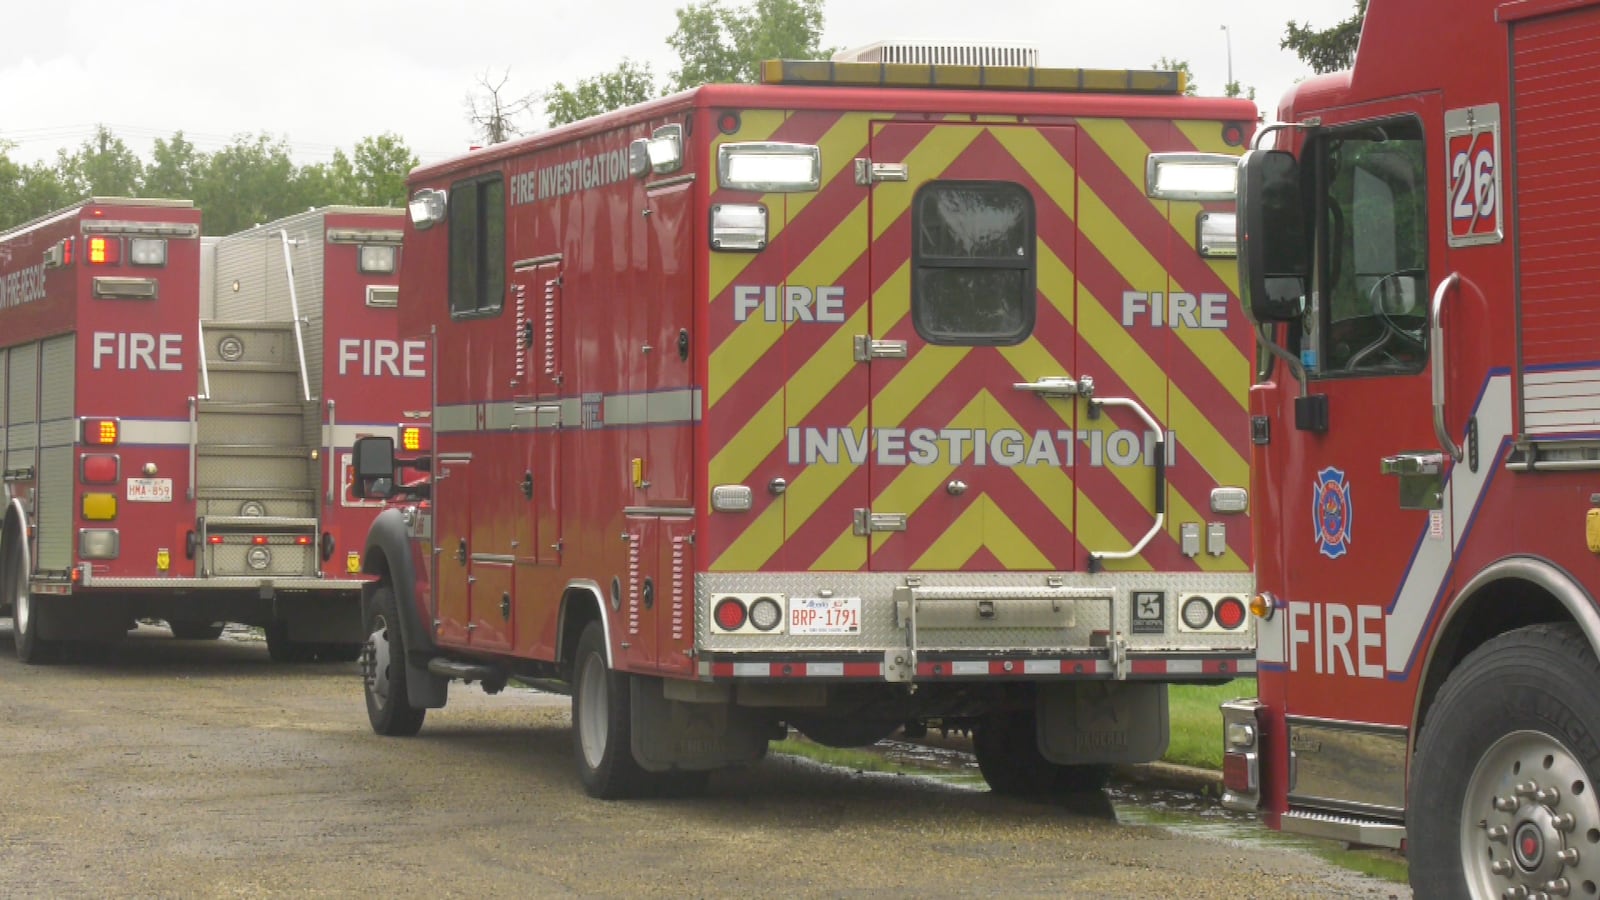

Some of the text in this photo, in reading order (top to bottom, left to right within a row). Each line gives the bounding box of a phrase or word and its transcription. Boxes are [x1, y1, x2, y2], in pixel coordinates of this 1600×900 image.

[510, 148, 628, 206] FIRE INVESTIGATION
[1452, 149, 1497, 218] 26
[733, 285, 846, 322] FIRE
[1121, 291, 1228, 328] FIRE
[92, 331, 184, 372] FIRE
[338, 338, 427, 378] FIRE
[787, 427, 1176, 467] INVESTIGATION
[792, 609, 858, 626] BRP-1791
[1288, 601, 1384, 679] FIRE
